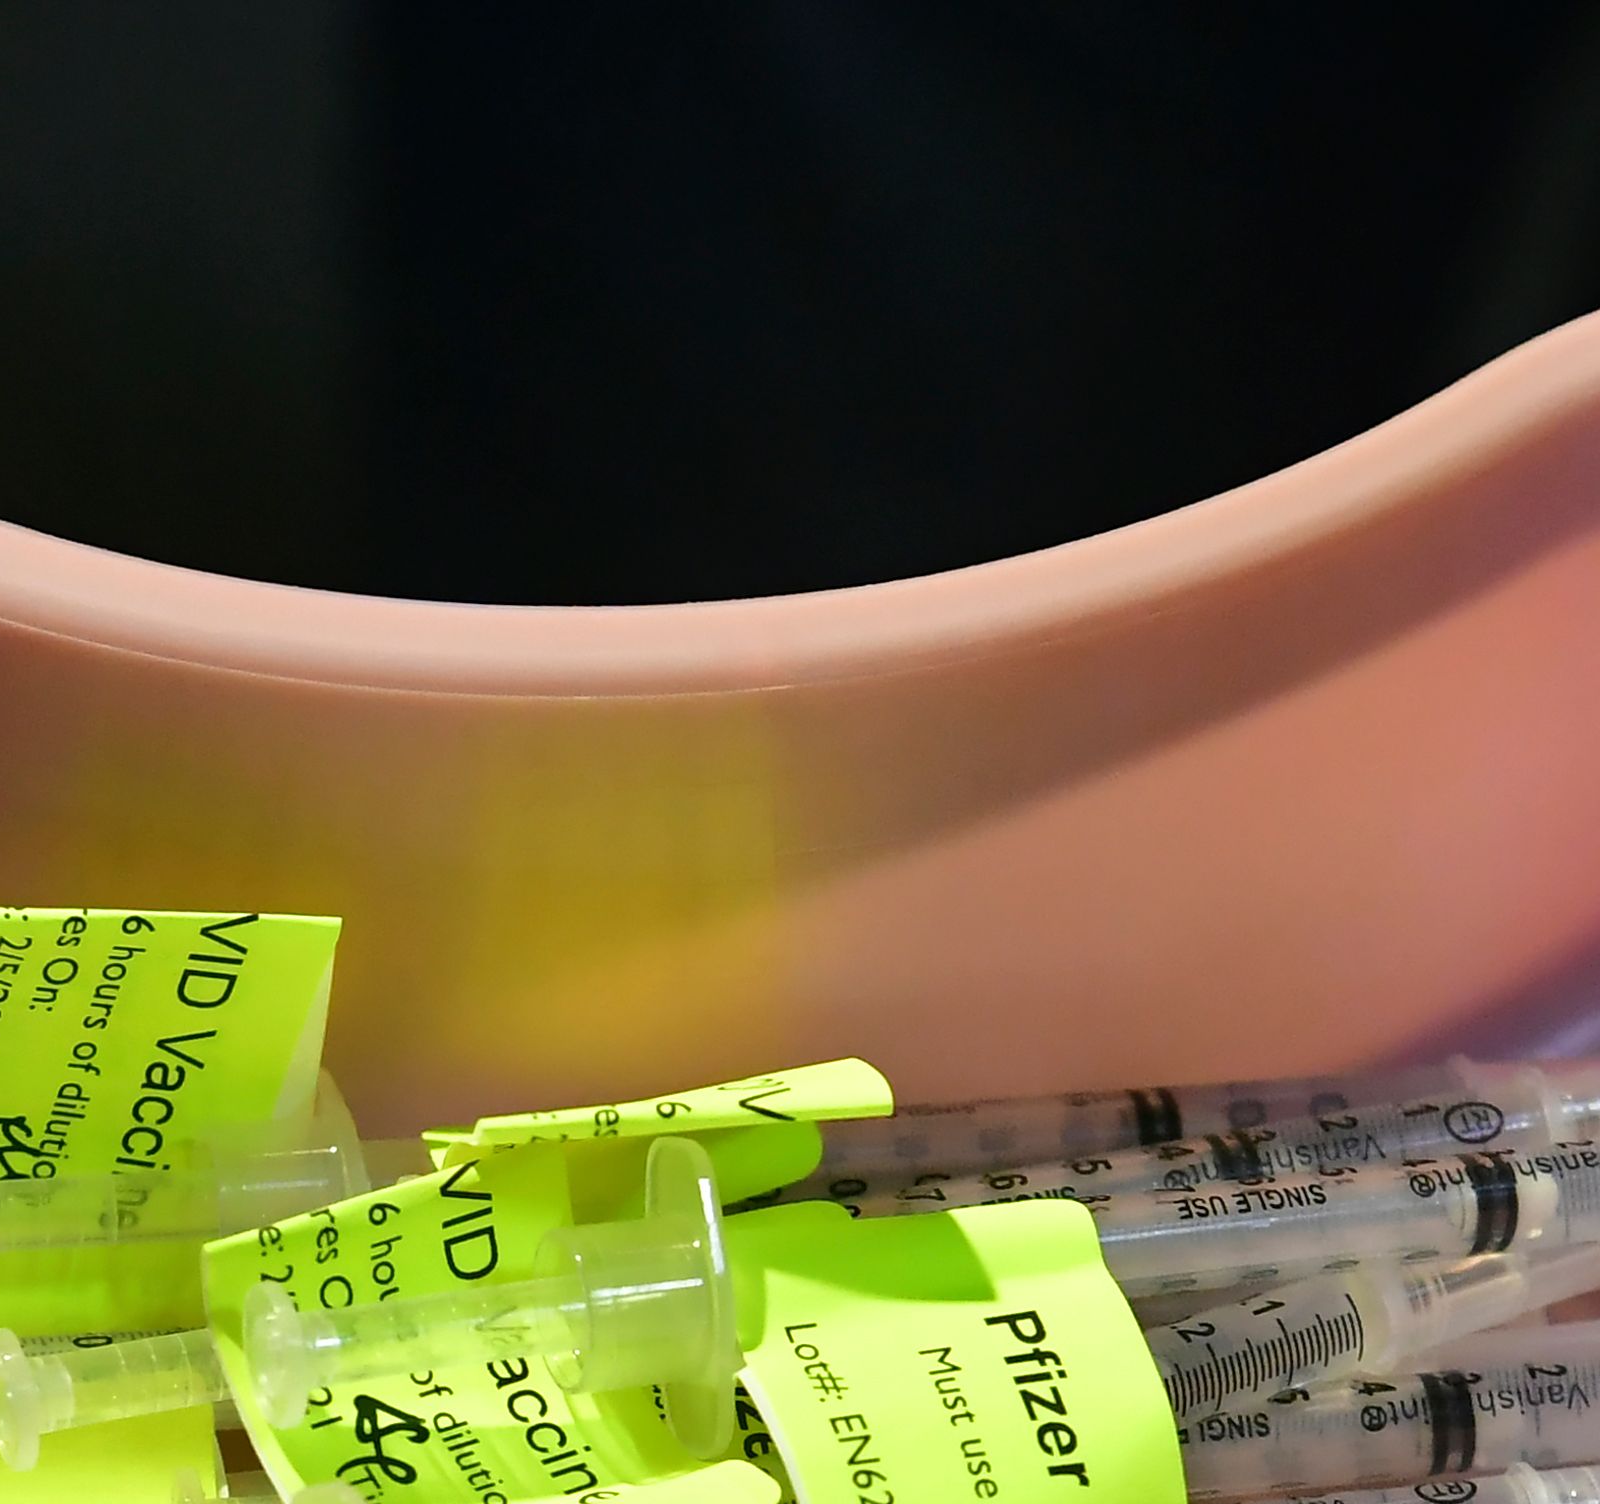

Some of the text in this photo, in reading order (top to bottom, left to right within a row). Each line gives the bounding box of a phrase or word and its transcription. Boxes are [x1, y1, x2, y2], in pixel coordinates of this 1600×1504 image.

[121, 915, 156, 936] 6
[177, 913, 259, 1009] VID
[27, 956, 80, 1013] On:
[83, 945, 148, 1030] hours
[66, 1041, 101, 1077] of
[367, 1202, 401, 1227] 6
[439, 1158, 500, 1281] VID
[1172, 1184, 1328, 1220] SINGLE USE
[783, 1320, 850, 1405] Lot#:
[983, 1309, 1092, 1488] Pfizer
[917, 1344, 977, 1428] Must
[958, 1437, 1000, 1501] use
